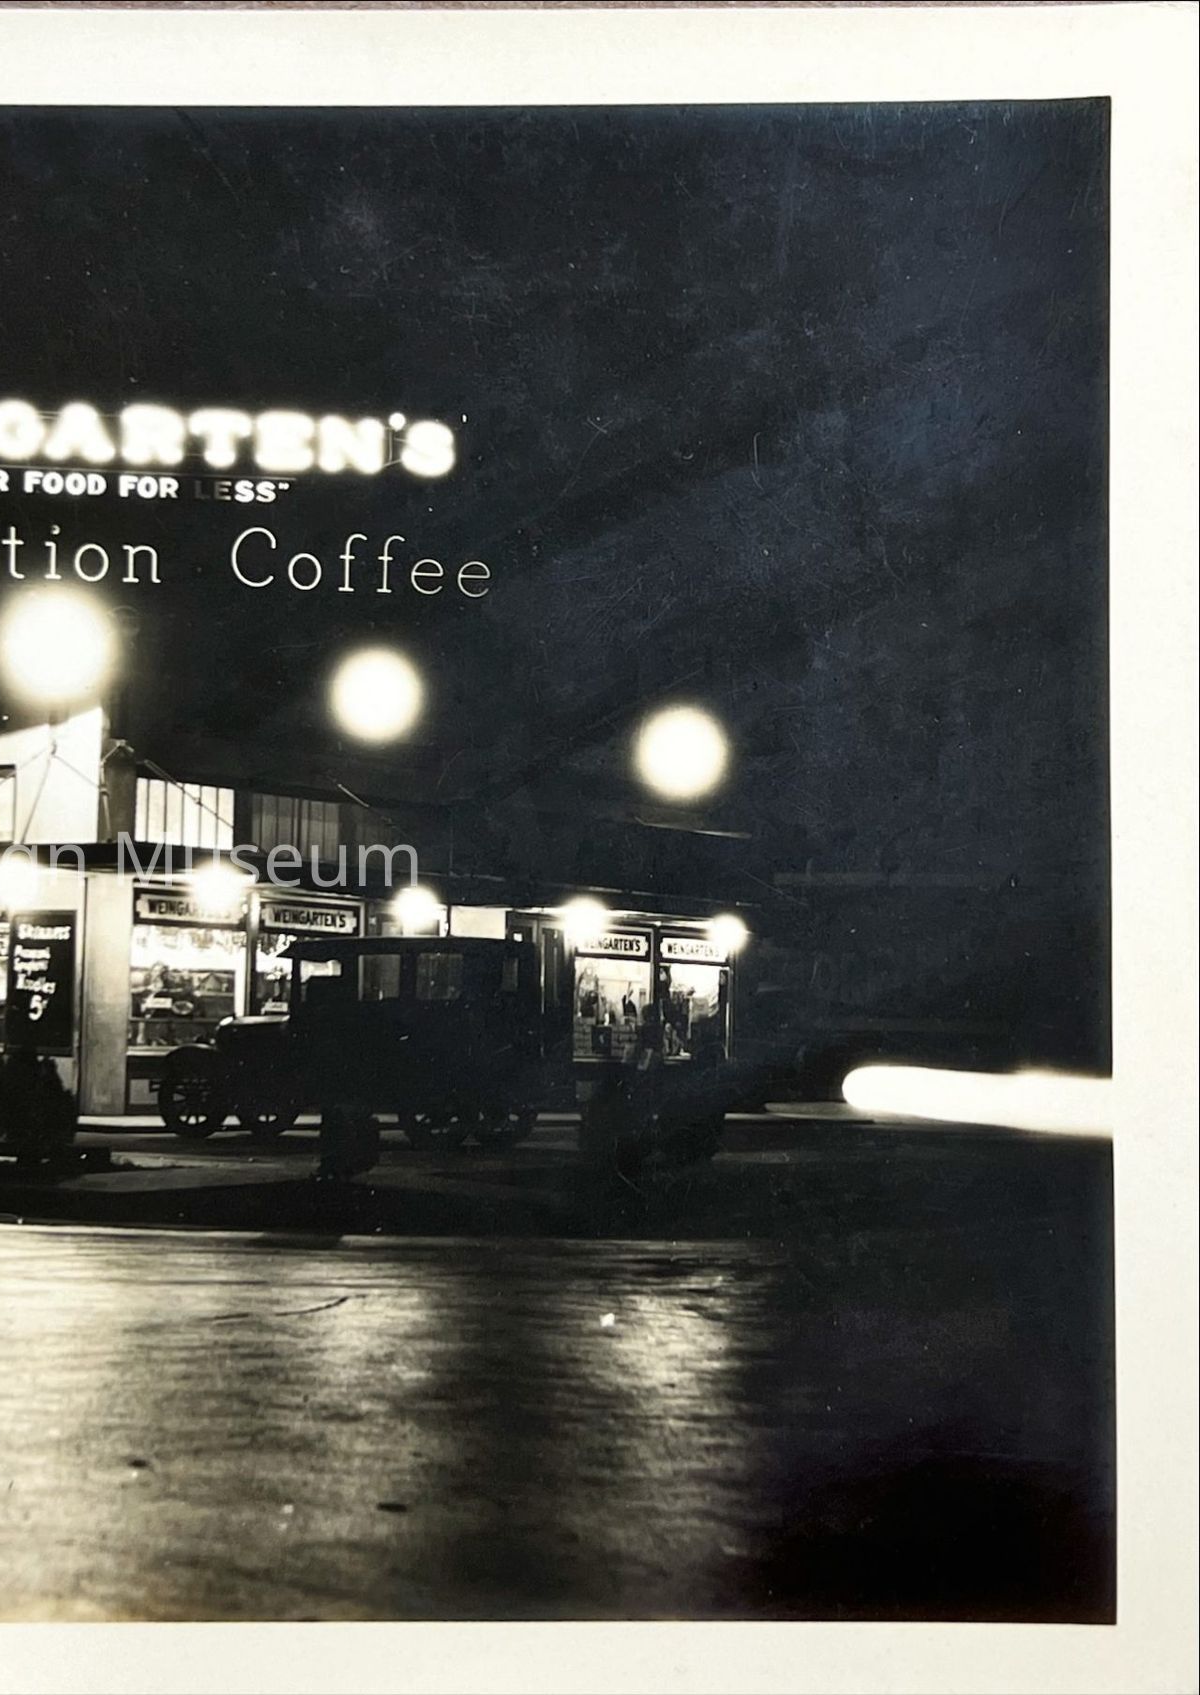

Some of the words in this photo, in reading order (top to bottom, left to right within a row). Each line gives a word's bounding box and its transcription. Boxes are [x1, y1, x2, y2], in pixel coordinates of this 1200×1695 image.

[23, 470, 106, 497] FOOD
[118, 475, 179, 499] FOR
[230, 527, 493, 598] Coffee
[272, 904, 347, 929] WEINGARTEN'S
